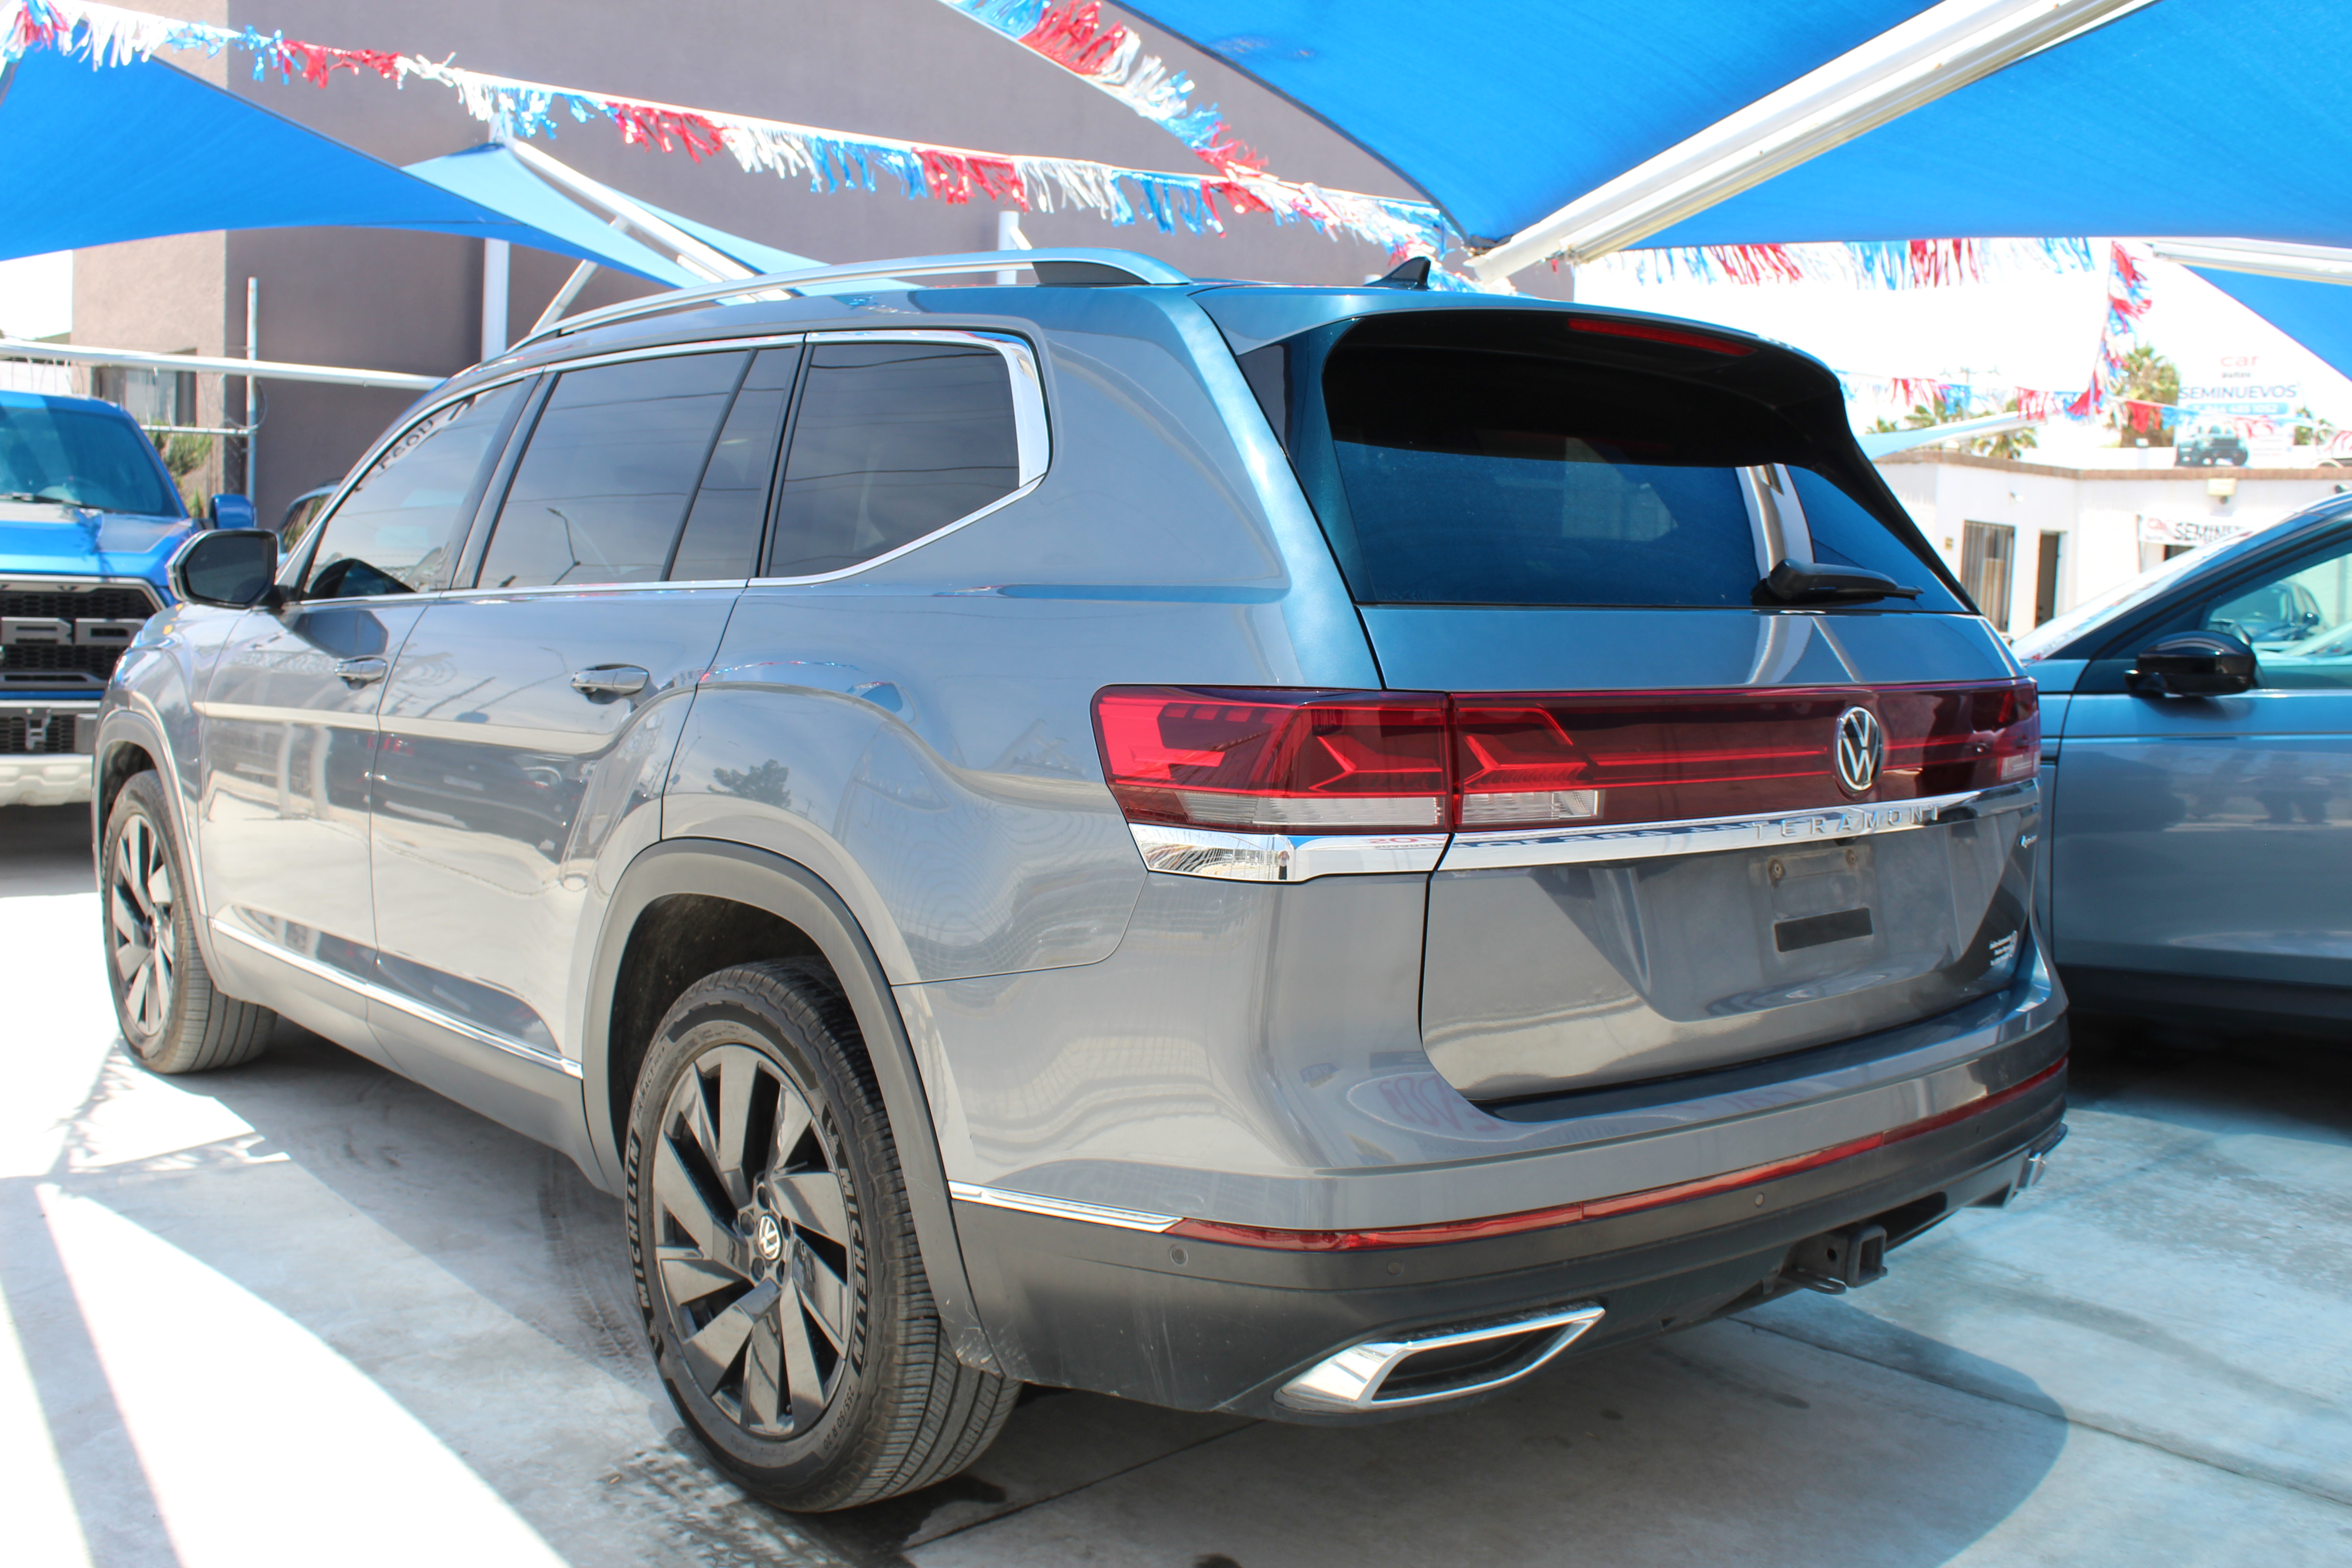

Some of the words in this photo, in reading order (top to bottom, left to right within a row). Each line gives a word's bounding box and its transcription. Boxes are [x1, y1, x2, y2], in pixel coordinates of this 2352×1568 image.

[2178, 384, 2297, 399] SEMINUEVOS
[1752, 805, 1941, 841] TERAMONT
[627, 1139, 650, 1308] MICHELIN
[839, 1167, 867, 1365] MICHELIN
[837, 1384, 855, 1428] 255/50
[823, 1433, 832, 1450] 20
[832, 1424, 838, 1438] R
